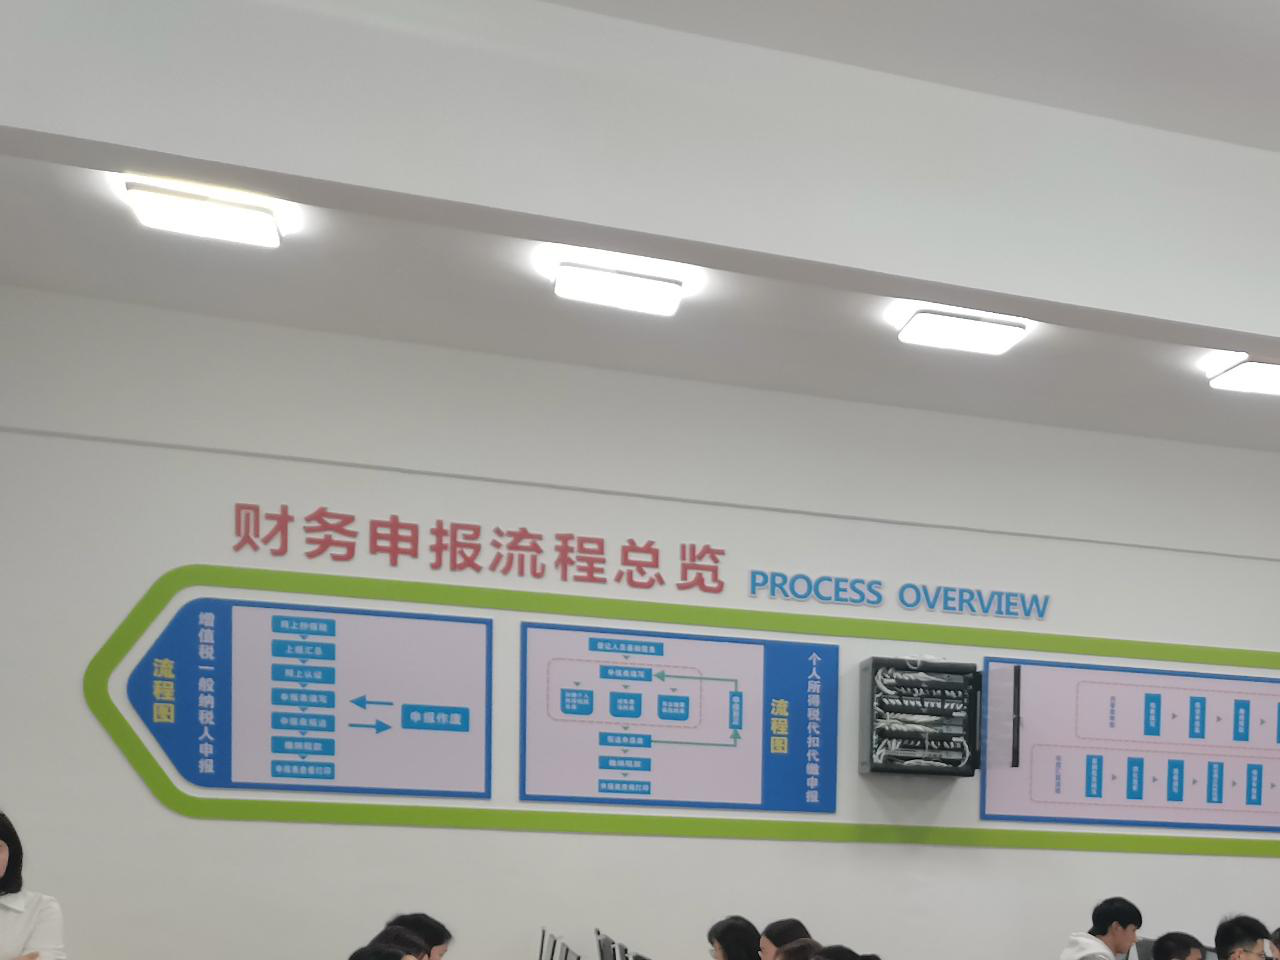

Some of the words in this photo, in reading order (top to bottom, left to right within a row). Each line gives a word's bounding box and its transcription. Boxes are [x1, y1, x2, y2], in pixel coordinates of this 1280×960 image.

[232, 502, 727, 594] 财务申报流程总览
[749, 569, 882, 606] PROCESS
[899, 582, 1049, 619] OVERVIEW
[152, 658, 175, 723] 流程图
[198, 612, 215, 774] 增值税一般纳税人申报
[770, 698, 789, 754] 流程图
[805, 651, 822, 803] 个人所得税代扣代缴申报
